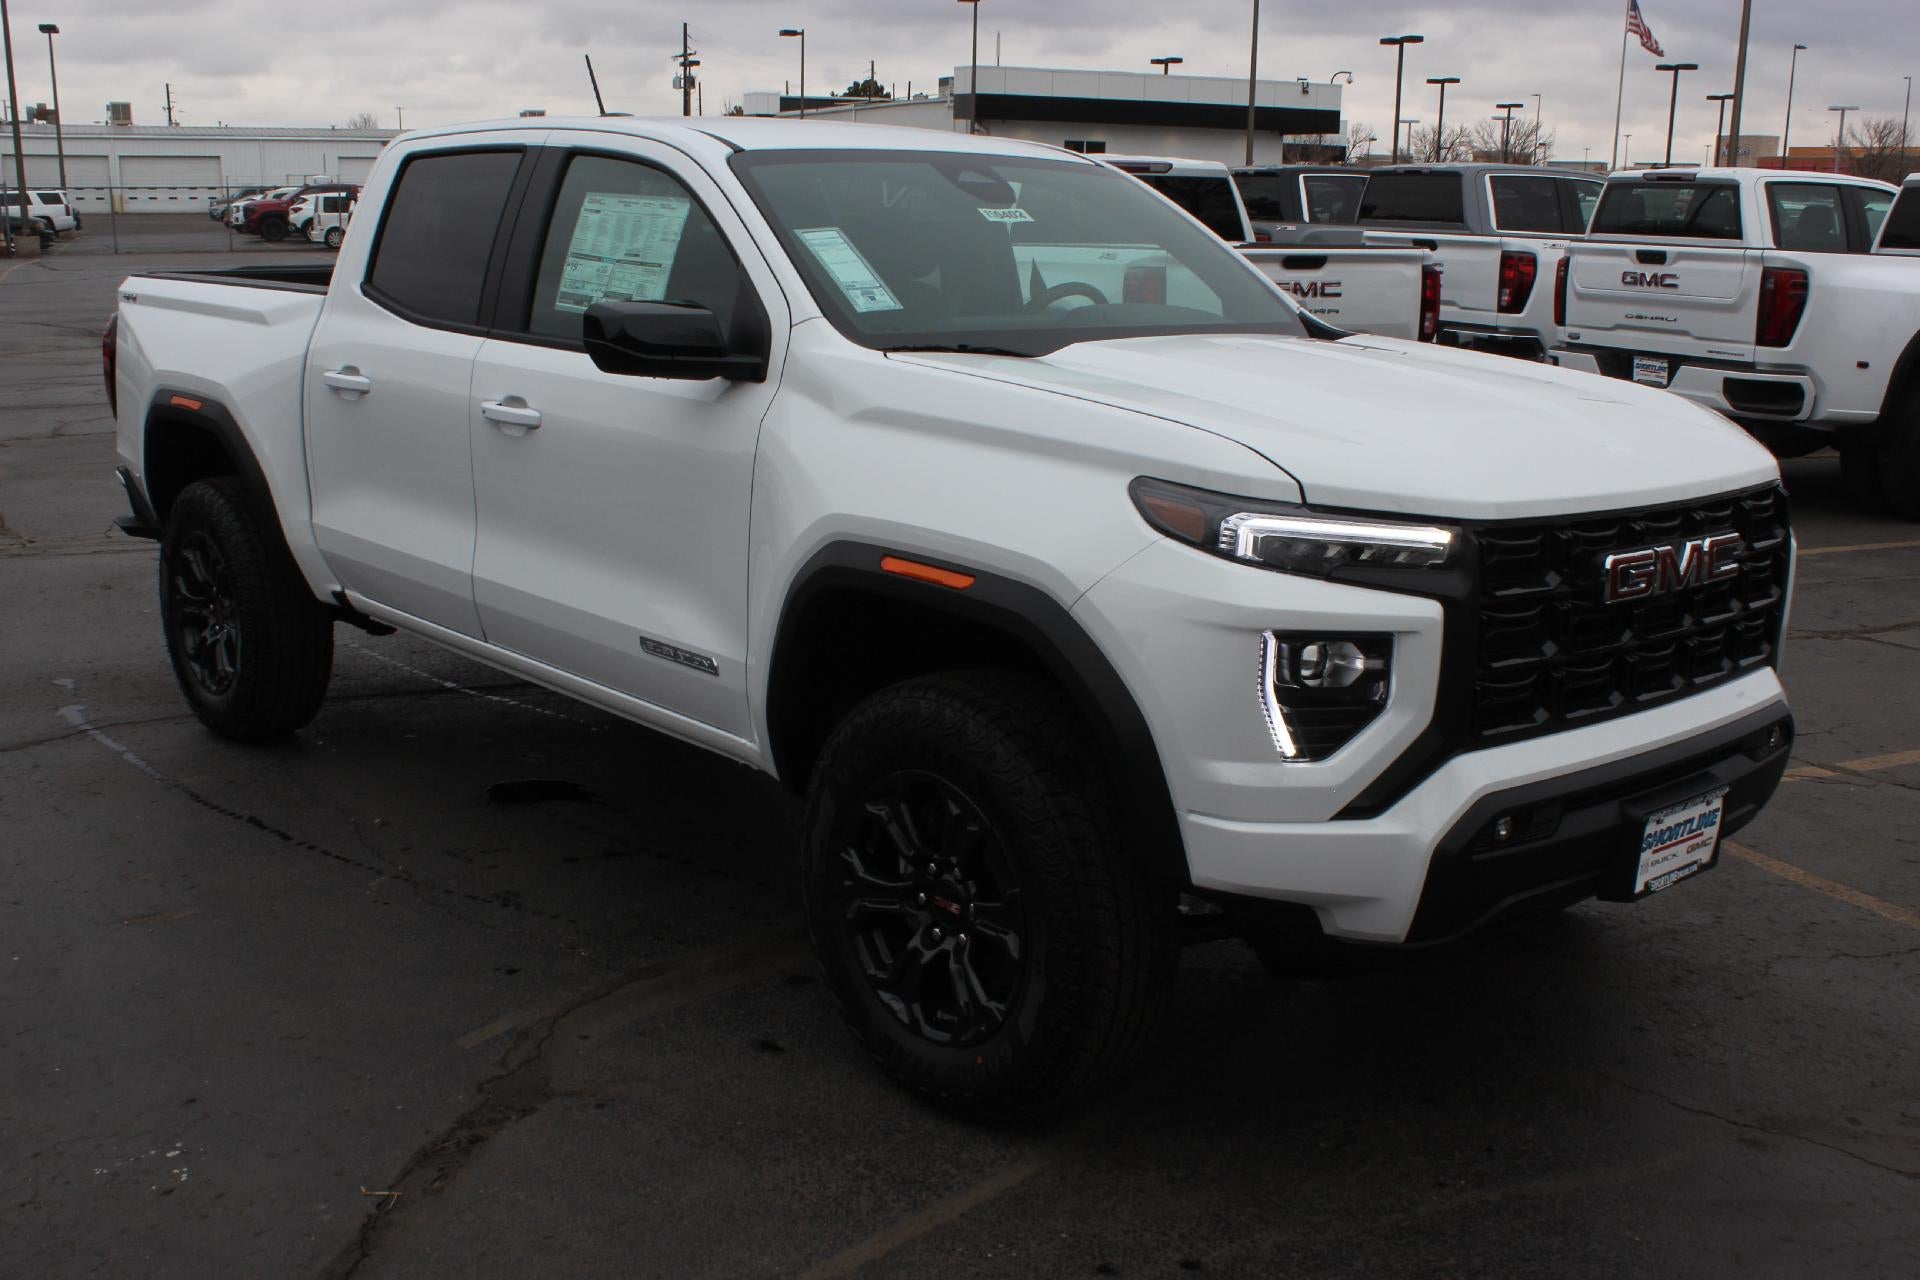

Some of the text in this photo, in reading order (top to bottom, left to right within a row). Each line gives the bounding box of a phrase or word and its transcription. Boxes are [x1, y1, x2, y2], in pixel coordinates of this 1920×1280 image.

[1621, 270, 1680, 289] GMC
[1624, 312, 1678, 323] DENALI
[1604, 532, 1741, 604] GMC
[1640, 808, 1720, 853] SHORTLINE
[1686, 836, 1714, 854] GMC
